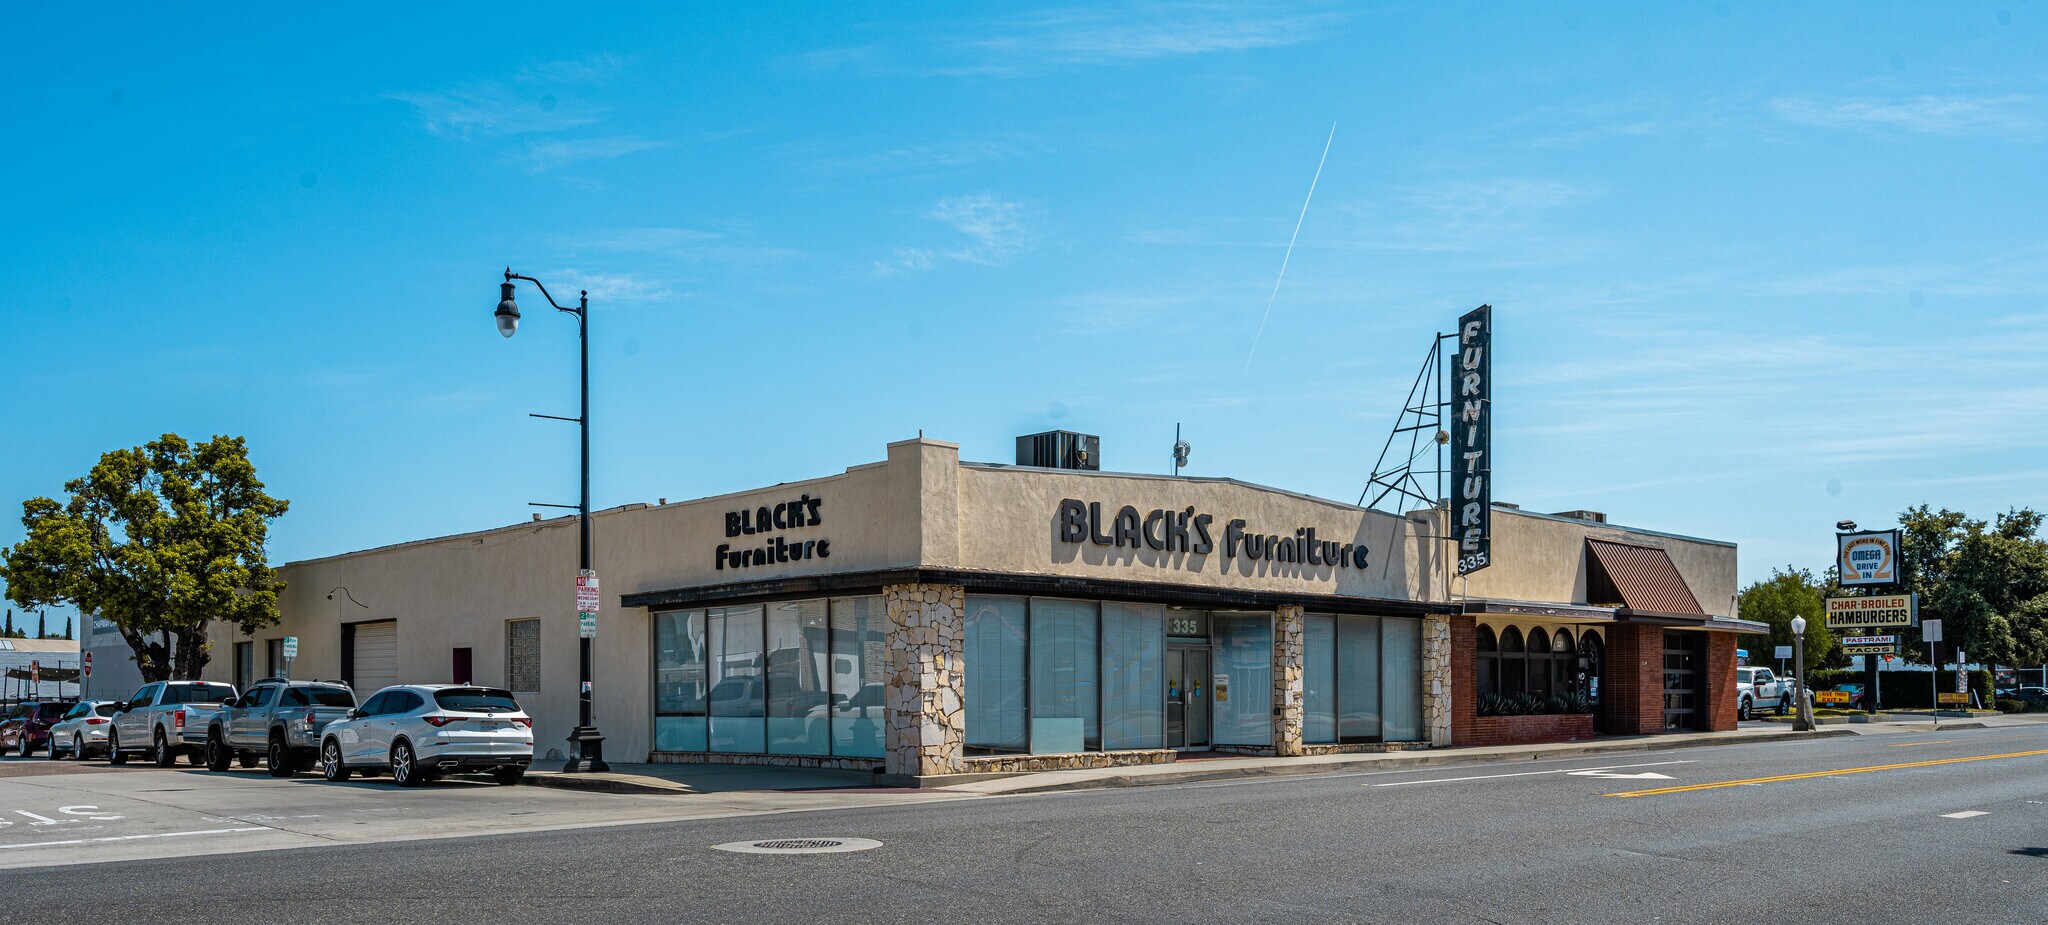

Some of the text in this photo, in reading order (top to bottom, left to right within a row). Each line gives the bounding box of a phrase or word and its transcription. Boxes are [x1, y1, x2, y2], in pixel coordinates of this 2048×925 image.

[1462, 320, 1483, 551] FURNITURE
[725, 494, 822, 537] BLACK'S
[1061, 498, 1369, 569] BLACK'S Furniture
[716, 537, 830, 570] Furniture
[1458, 551, 1487, 573] 335
[1852, 550, 1881, 561] OMEGA
[578, 578, 586, 586] NO
[1173, 619, 1197, 634] 335
[1829, 609, 1907, 624] HAMBURGERS
